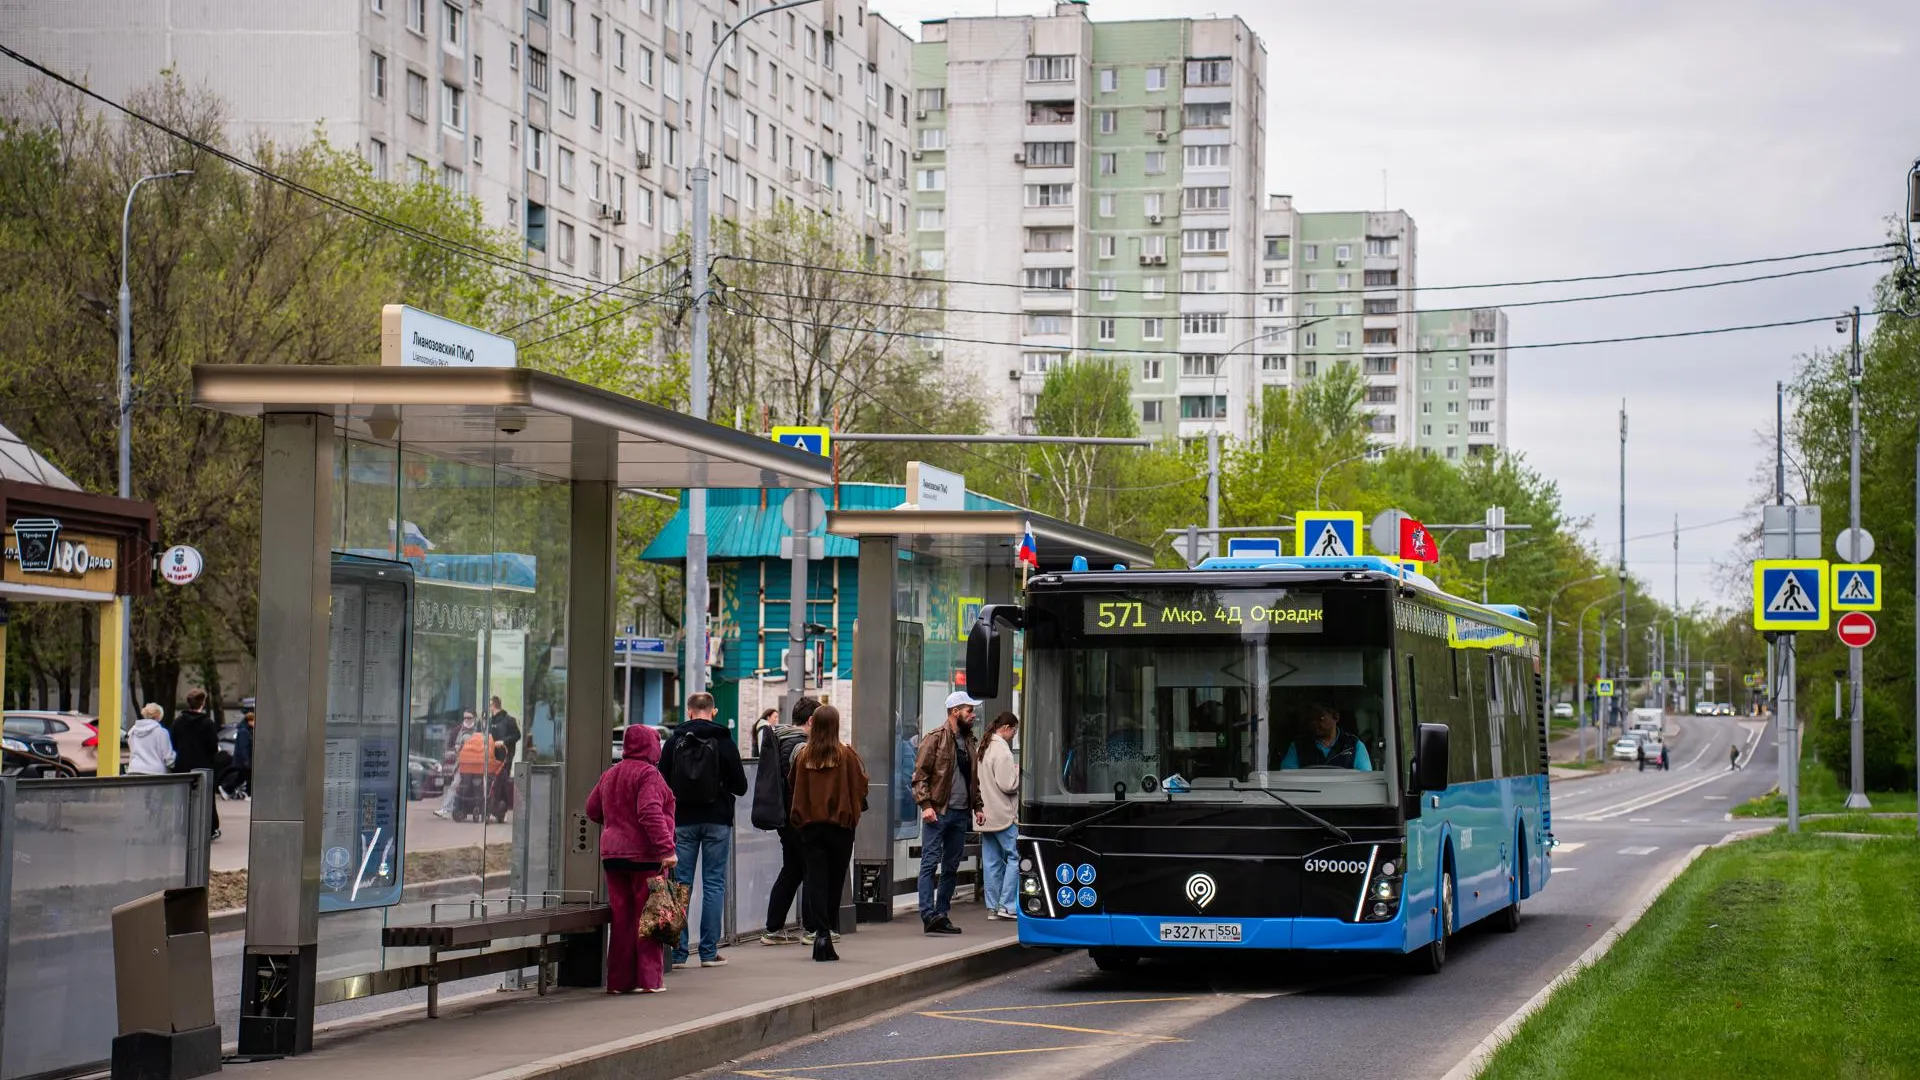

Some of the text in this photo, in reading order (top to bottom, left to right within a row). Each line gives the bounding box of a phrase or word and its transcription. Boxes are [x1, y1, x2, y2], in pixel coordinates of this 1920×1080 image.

[413, 331, 474, 362] Лианозовский ПКиО
[1098, 602, 1147, 628] 571
[1161, 606, 1207, 625] Мкр.
[1214, 606, 1243, 625] 4Д
[1304, 859, 1368, 874] 6190009
[1217, 925, 1238, 936] 550
